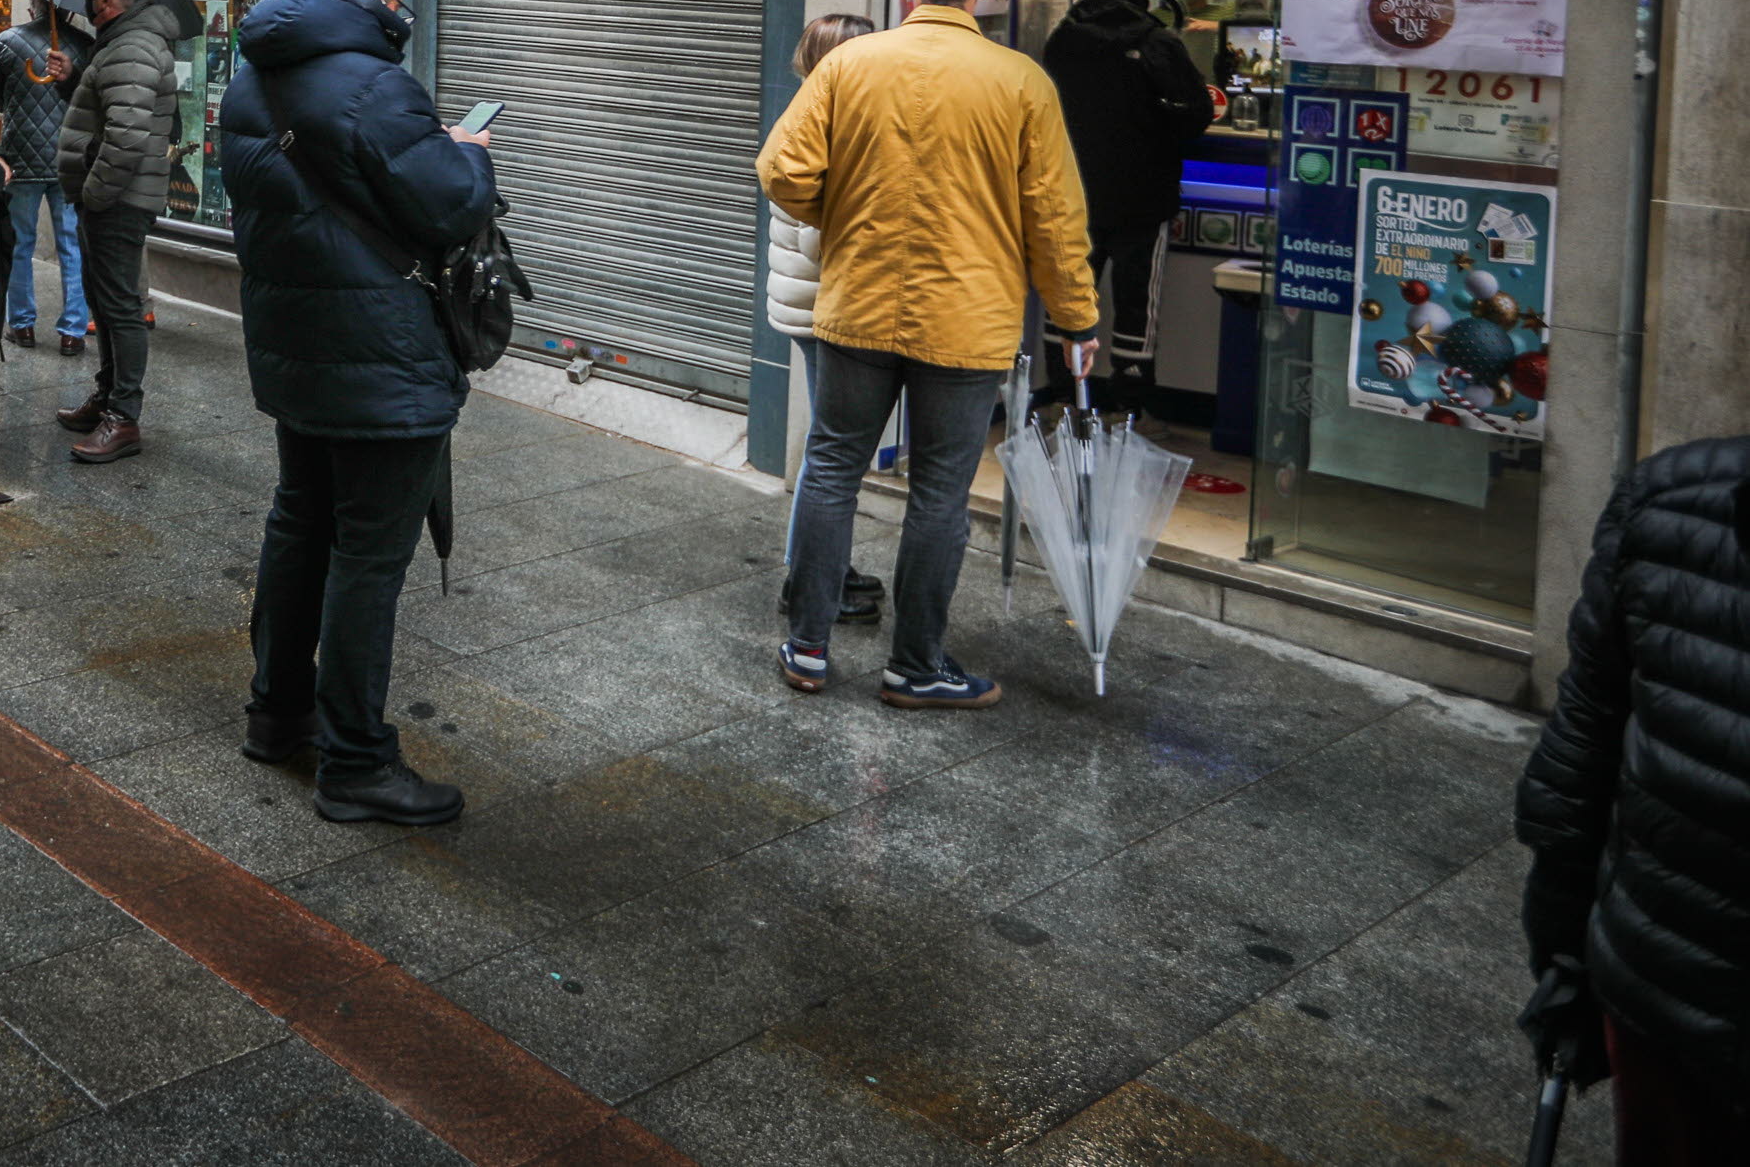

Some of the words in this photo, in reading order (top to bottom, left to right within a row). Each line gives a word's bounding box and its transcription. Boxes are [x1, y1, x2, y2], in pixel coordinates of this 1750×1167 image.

[1397, 67, 1543, 104] 12061
[1377, 185, 1392, 213] 6
[1396, 192, 1468, 223] ENERO
[1375, 215, 1418, 232] SORTEO
[1283, 235, 1354, 259] Loterías
[1375, 228, 1469, 251] EXTRAORDINARIO
[1375, 241, 1389, 255] DE
[1281, 259, 1355, 284] Apuesta
[1374, 255, 1403, 277] 700
[1403, 259, 1448, 274] MILLONES
[1279, 281, 1340, 305] Estado
